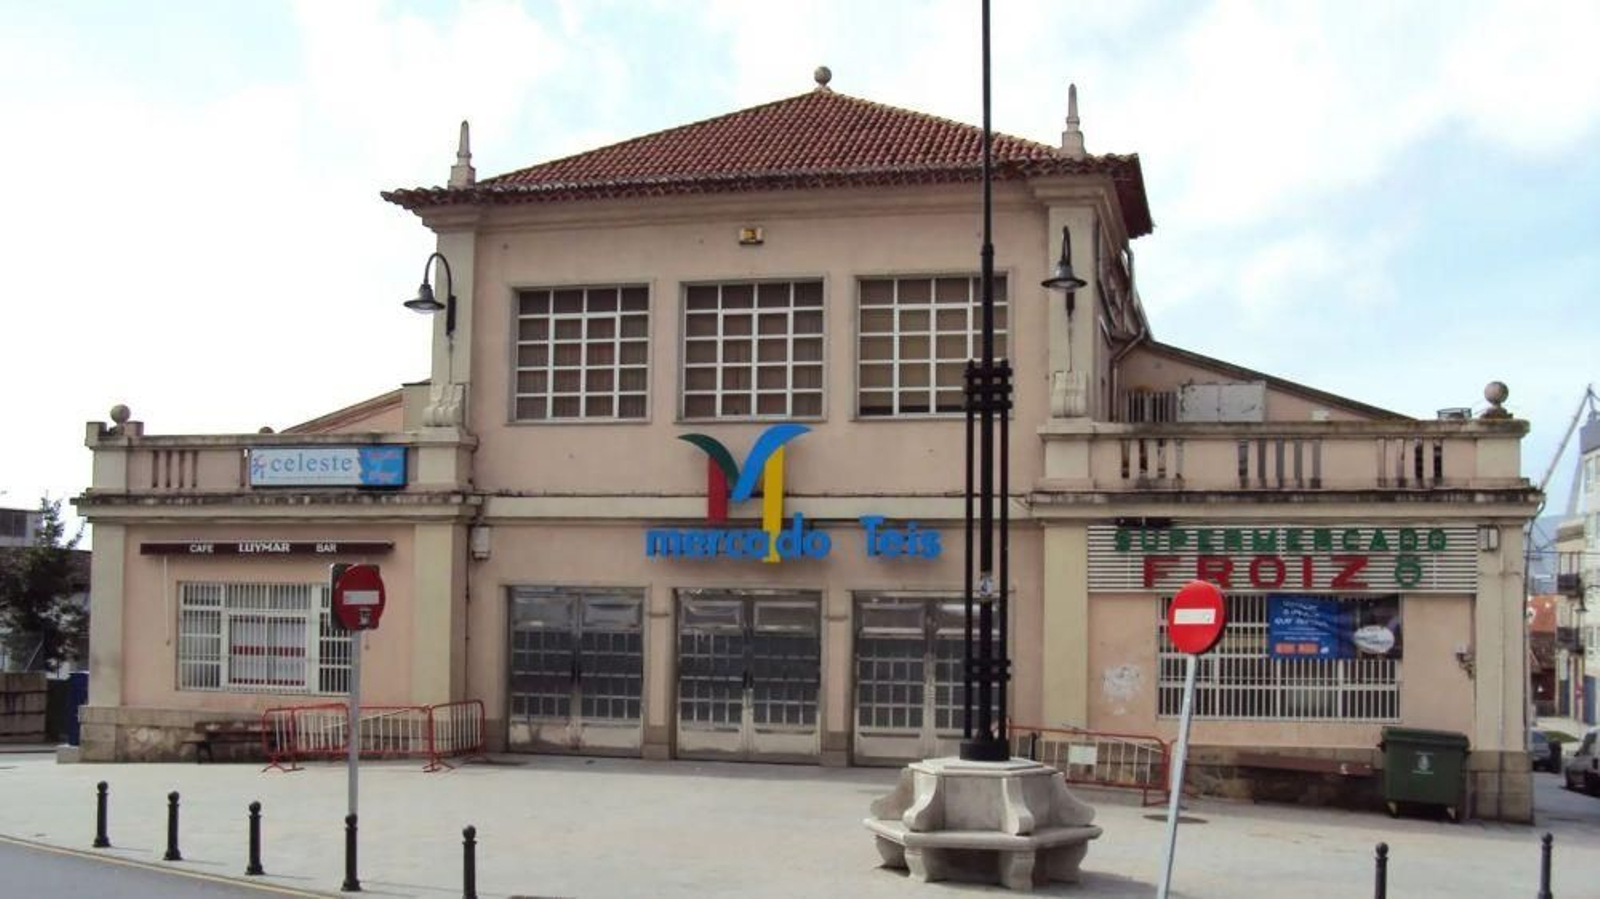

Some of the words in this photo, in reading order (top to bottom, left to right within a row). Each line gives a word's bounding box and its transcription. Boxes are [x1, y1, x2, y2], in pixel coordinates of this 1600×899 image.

[270, 453, 353, 473] celeste
[189, 544, 215, 554] CAFE
[238, 541, 290, 553] LUYMAR
[316, 543, 337, 553] BAR
[646, 511, 832, 561] mercado
[859, 515, 942, 559] Teis
[1114, 527, 1448, 552] SUPERMERCADO
[1142, 554, 1369, 589] FROIZ
